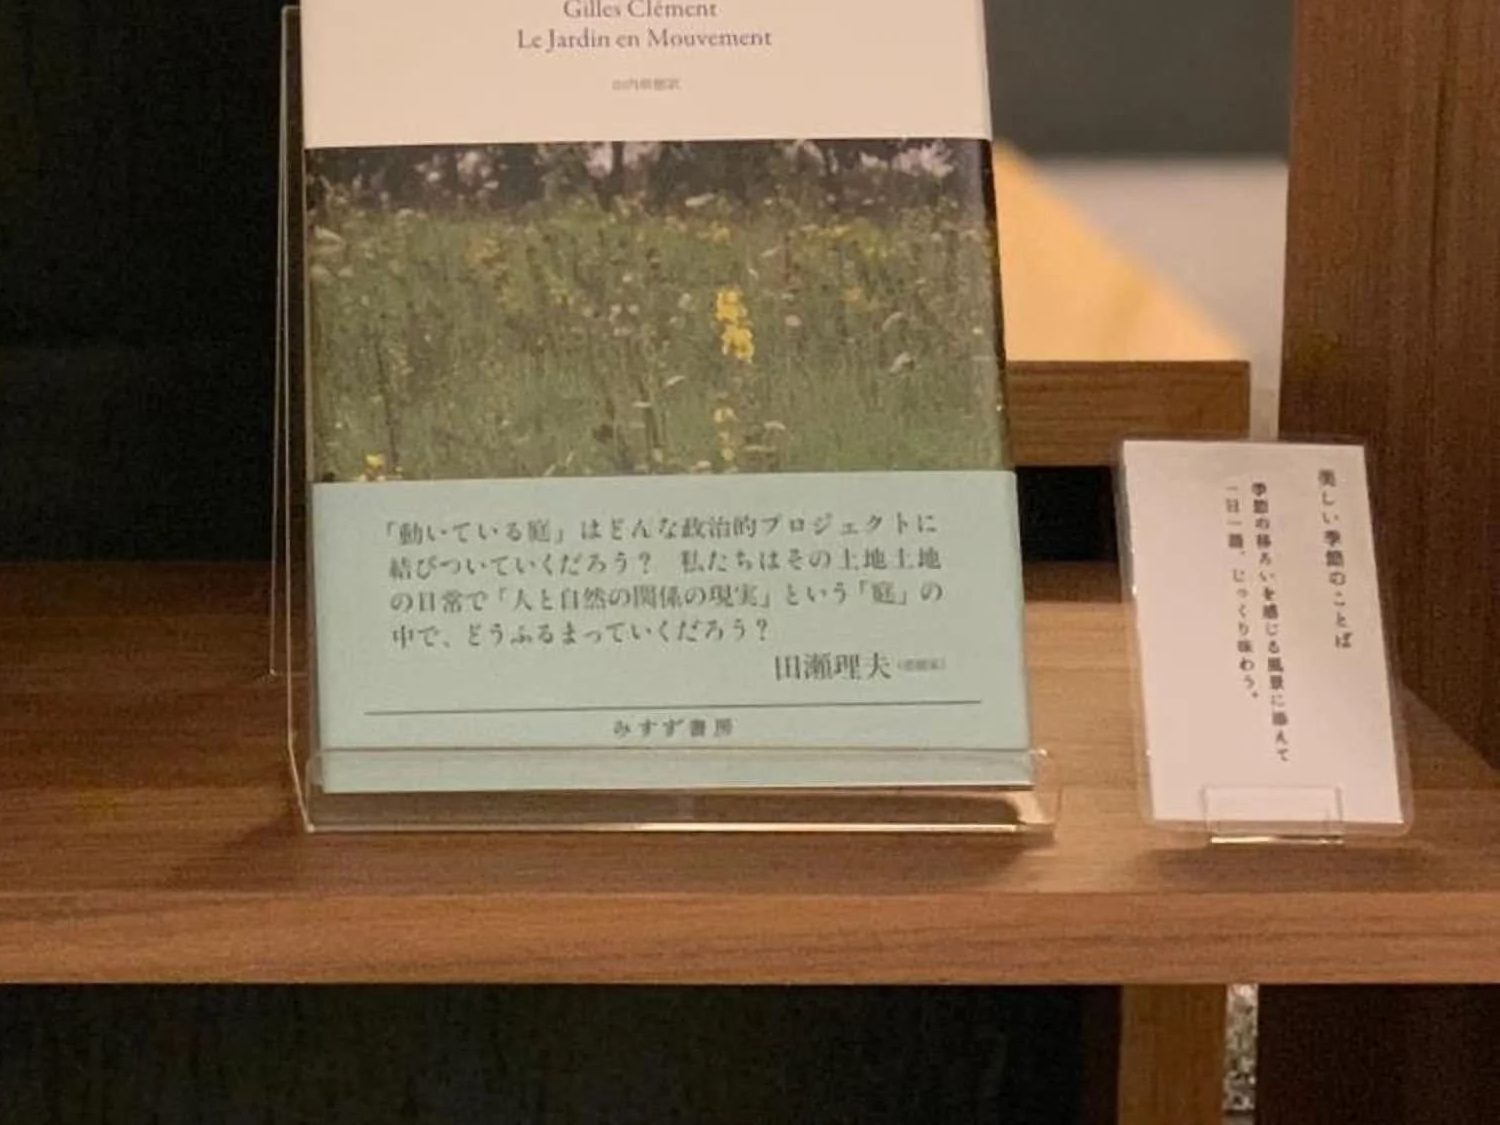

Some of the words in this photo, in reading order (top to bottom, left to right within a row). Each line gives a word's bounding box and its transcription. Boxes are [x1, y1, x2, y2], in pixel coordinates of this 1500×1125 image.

[517, 29, 543, 49] Le
[546, 27, 610, 54] Jardin
[614, 34, 641, 49] en
[647, 28, 773, 48] Mouvement
[385, 512, 938, 546] 「動いている庭」はどんな政治的プロジェクトに
[389, 551, 652, 580] 結びついていくだろう？
[681, 547, 942, 573] 私たちはその土地土地
[1317, 468, 1353, 650] 美しい季節のことば
[390, 580, 943, 613] の日常で「人と自然の関係の現実」という「庭」の
[392, 618, 769, 649] 中で、どうふるまっていくだろう？
[774, 652, 892, 681] 田瀬理夫
[613, 718, 733, 738] みすず書房
